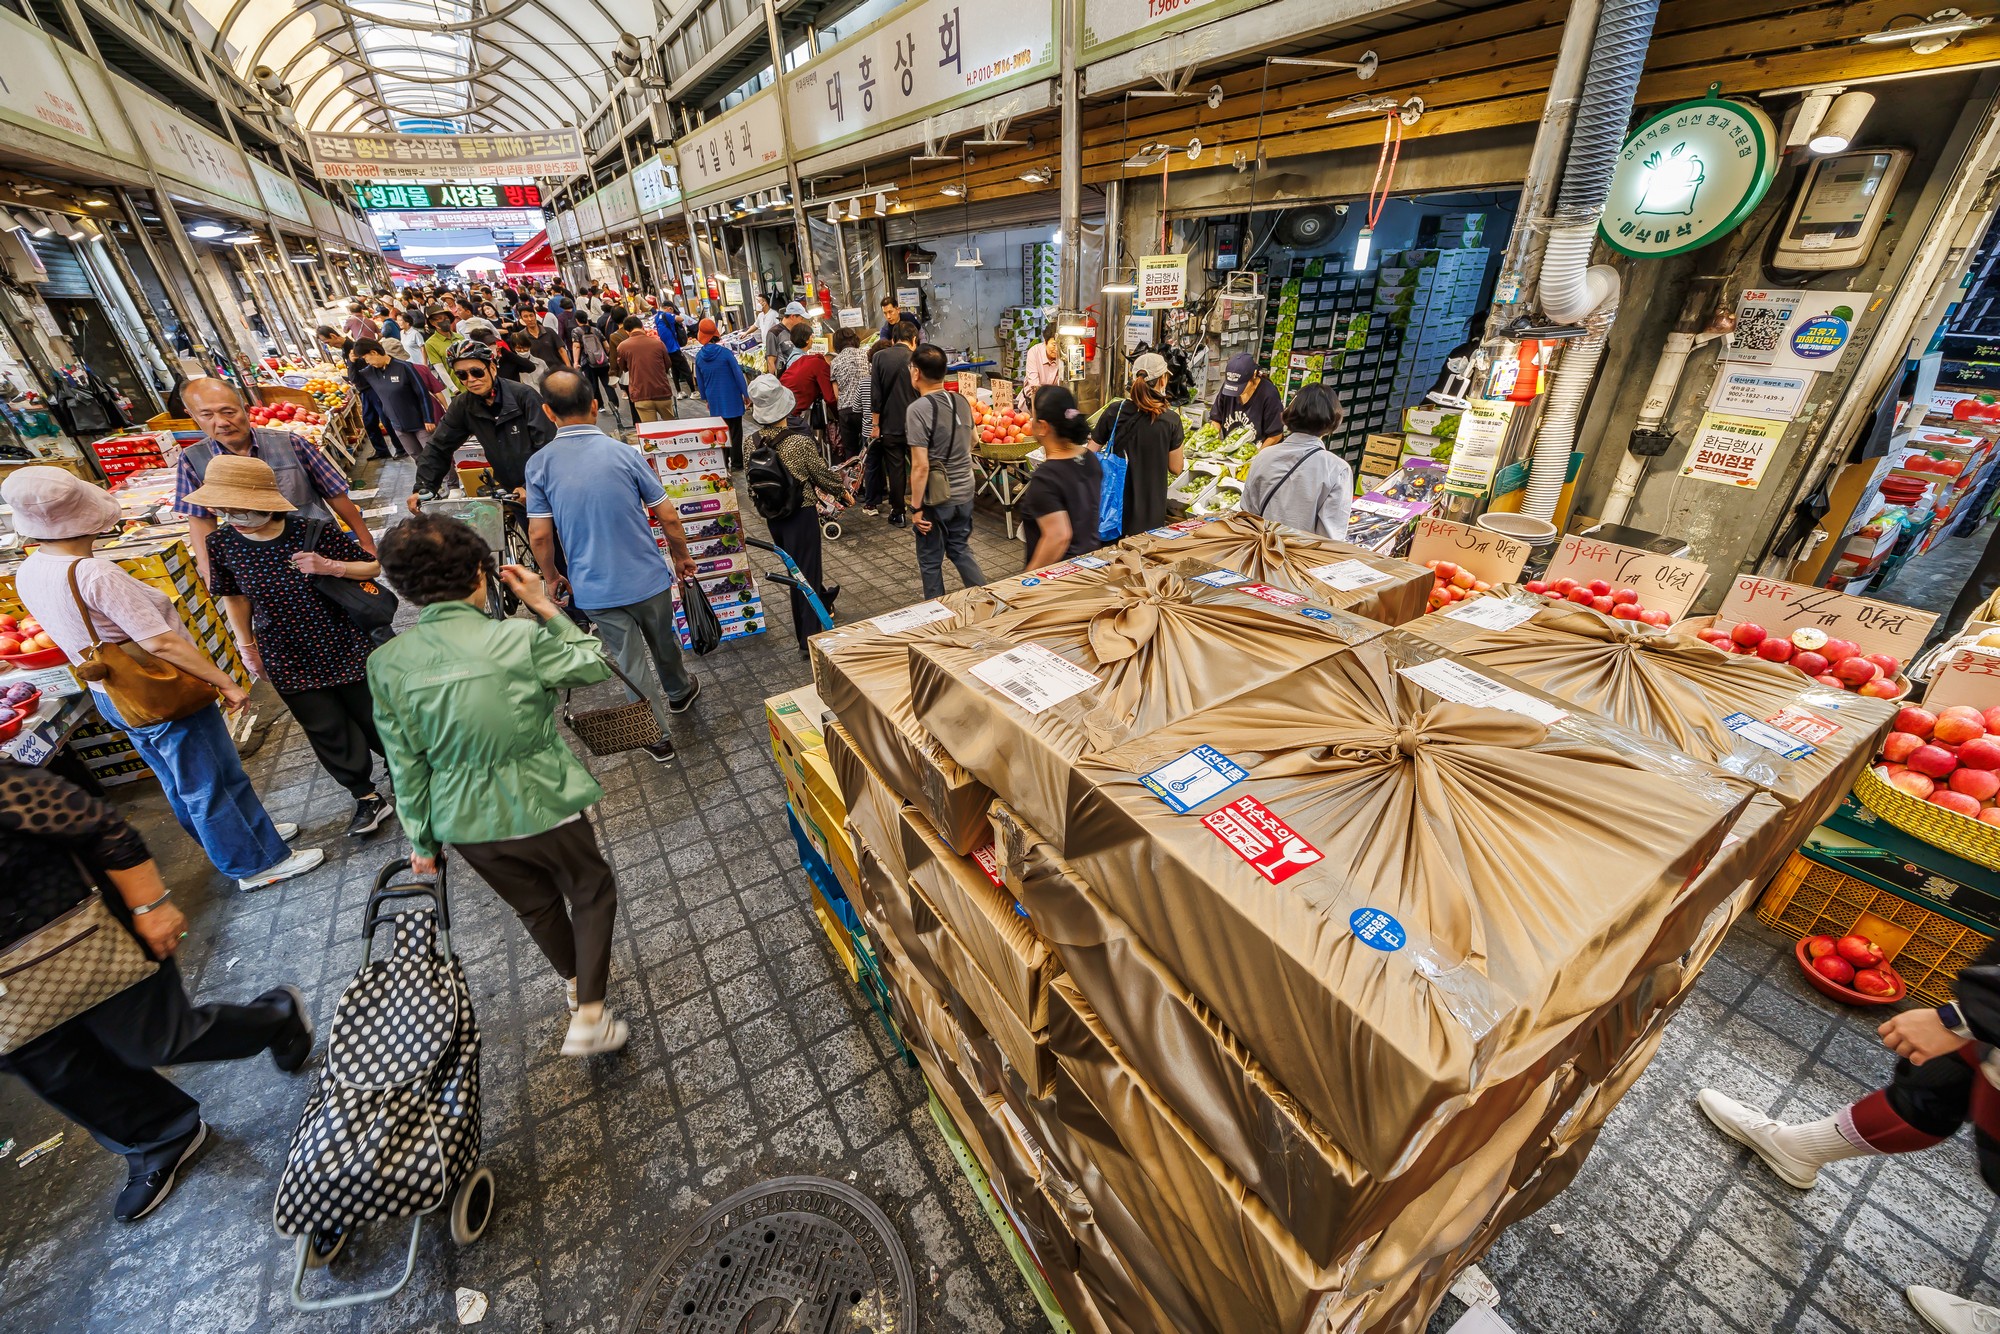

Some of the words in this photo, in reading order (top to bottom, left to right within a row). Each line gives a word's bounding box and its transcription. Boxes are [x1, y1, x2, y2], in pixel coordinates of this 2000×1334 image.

[826, 7, 962, 122] 대흥상회
[697, 121, 753, 176] 대일청과
[1624, 123, 1671, 161] 산지직송
[1677, 114, 1702, 128] 신선
[1707, 114, 1731, 130] 청과
[1729, 126, 1752, 158] 전문점
[441, 186, 497, 206] 시장을
[1619, 221, 1692, 243] 아삭아삭
[1146, 272, 1179, 284] 환급행사
[1145, 284, 1178, 296] 참여점포
[1744, 290, 1767, 301] 온누리
[1796, 336, 1841, 346] 피해지원금
[1808, 327, 1836, 336] 고유가
[1728, 391, 1784, 402] 9002-1832-1439-3
[1738, 427, 1766, 437] 환급행사
[1704, 435, 1763, 457] 환급행사
[1697, 450, 1757, 471] 참여점포
[1421, 519, 1458, 539] 아리수
[1456, 527, 1488, 552] 5개
[1495, 538, 1519, 563] 만원
[1565, 538, 1611, 566] 아리수
[1614, 552, 1640, 585] 7개
[1655, 566, 1690, 592] 만원
[1740, 579, 1793, 603] 아리수
[1787, 590, 1835, 626] 4개
[1858, 605, 1909, 635] 만원
[1193, 745, 1245, 782] 신선식품
[1141, 777, 1168, 797] 긴급배송
[1236, 797, 1296, 844] 파손주의
[1920, 876, 1959, 900] 梨
[1359, 914, 1392, 942] 냉장보관
[713, 1196, 783, 1235] 서울특별시
[786, 1195, 828, 1214] SEOUL
[828, 1200, 897, 1300] METROPOLITAN
